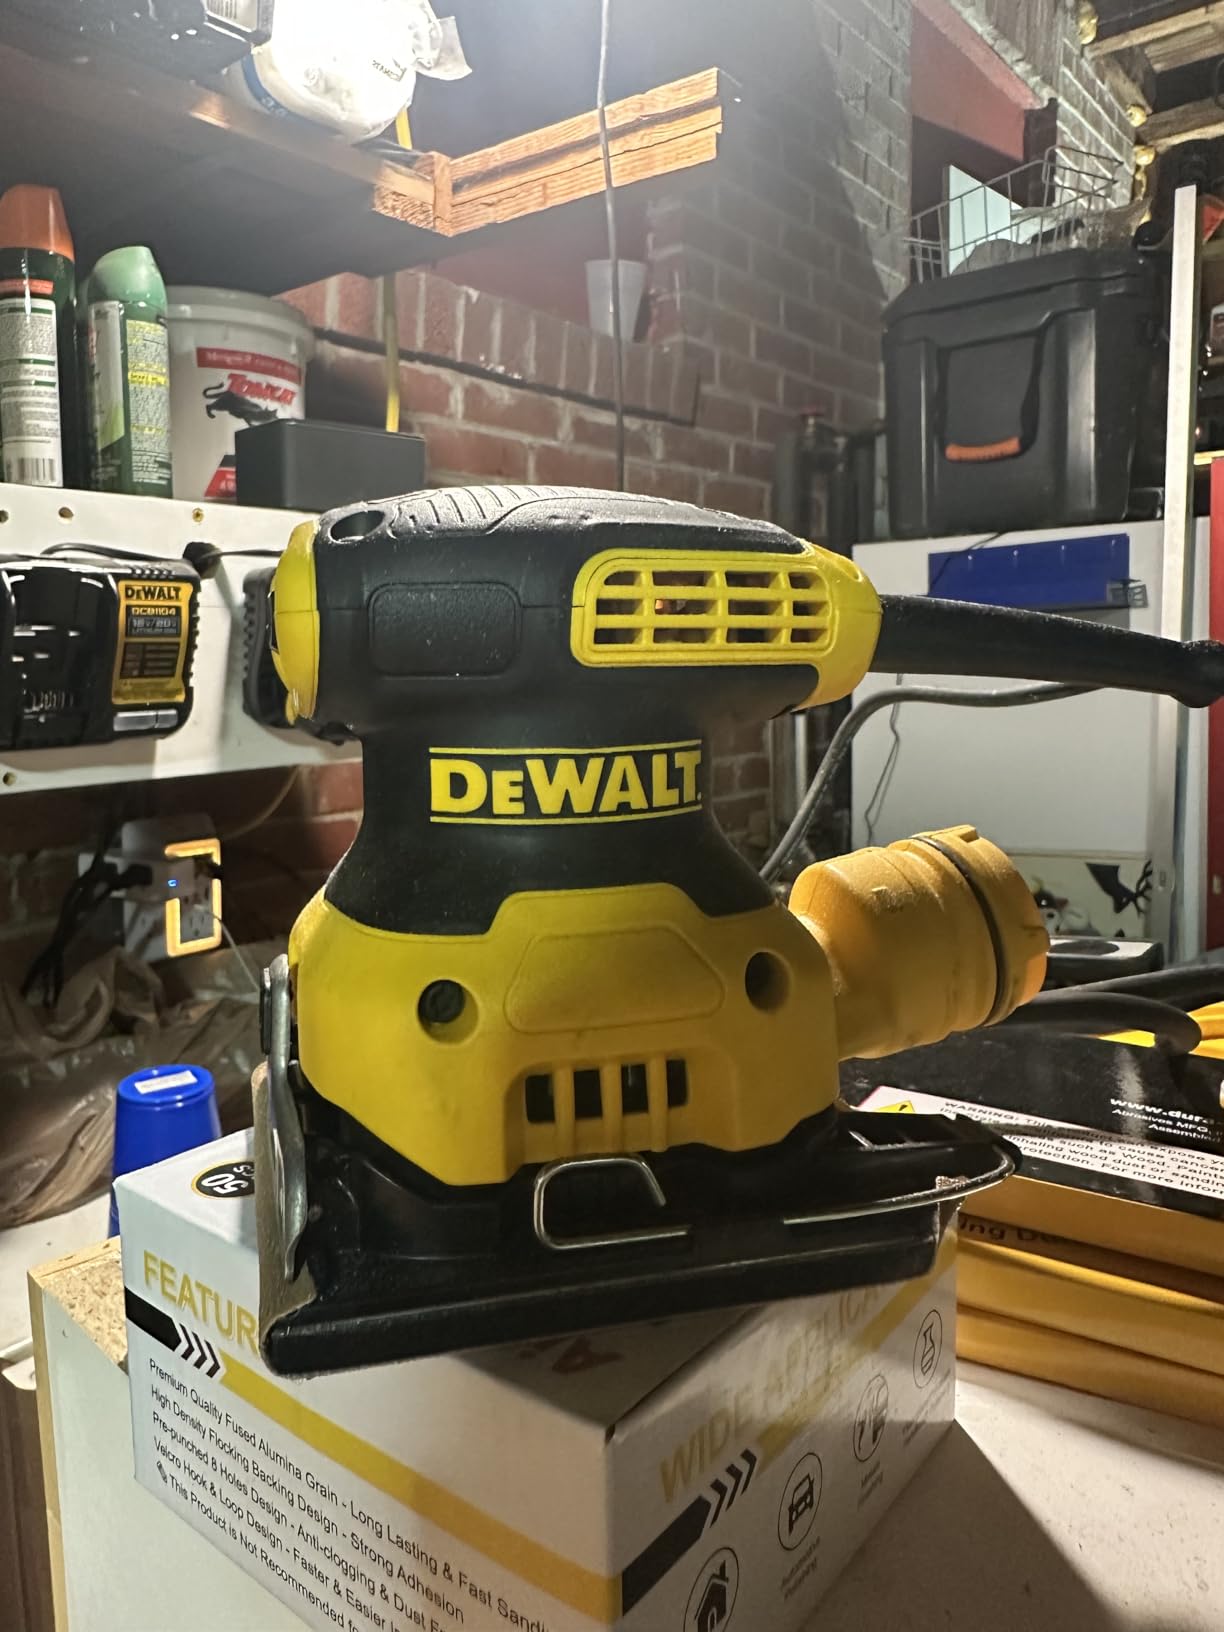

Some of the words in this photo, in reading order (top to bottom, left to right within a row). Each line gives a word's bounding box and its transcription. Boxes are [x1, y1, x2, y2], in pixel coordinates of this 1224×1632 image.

[944, 1102, 1019, 1121] WARNING:
[1149, 1145, 1207, 1162] expose
[1111, 1108, 1174, 1127] Abrasives
[1019, 1146, 1096, 1166] rotection.
[1100, 1163, 1129, 1173] For
[1132, 1170, 1175, 1184] more
[1059, 1139, 1094, 1151] such
[1098, 1148, 1117, 1156] as
[1121, 1152, 1171, 1169] Wood.
[1068, 1149, 1109, 1161] wood
[1111, 1158, 1147, 1170] dust
[1149, 1166, 1168, 1175] or
[1117, 1145, 1165, 1159] cause
[200, 1173, 249, 1195] 50
[149, 1358, 188, 1398] Premium
[190, 1388, 223, 1425] Quality
[225, 1412, 256, 1448] Fused
[258, 1438, 302, 1481] Alumina
[305, 1471, 338, 1506] Grain
[350, 1500, 383, 1539] Long
[387, 1524, 438, 1576] Lasting
[442, 1561, 454, 1584] &
[458, 1571, 493, 1610] Fast
[151, 1384, 171, 1411] High
[173, 1401, 207, 1440] Density
[209, 1427, 249, 1473] Flocking
[252, 1459, 295, 1507] Backing
[297, 1493, 338, 1537] Design
[350, 1531, 394, 1578] Strong
[396, 1564, 465, 1625] Adhesion
[152, 1410, 209, 1466] Pre-punched
[211, 1456, 218, 1472] 8
[219, 1462, 248, 1496] Holes
[250, 1486, 288, 1527] Design
[297, 1522, 376, 1596] Anti-clogging
[379, 1583, 390, 1604] &
[393, 1591, 426, 1631] Dust
[153, 1435, 181, 1469] Velcro
[183, 1459, 208, 1491] Hook
[209, 1481, 217, 1498] &
[219, 1487, 244, 1521] Loop
[246, 1509, 283, 1553] Design
[293, 1546, 330, 1589] Faster
[333, 1578, 343, 1599] &
[345, 1587, 386, 1631] Easier
[169, 1472, 189, 1501] This
[190, 1490, 228, 1536] Product
[239, 1531, 259, 1559] Not
[260, 1547, 345, 1629] Recommended
